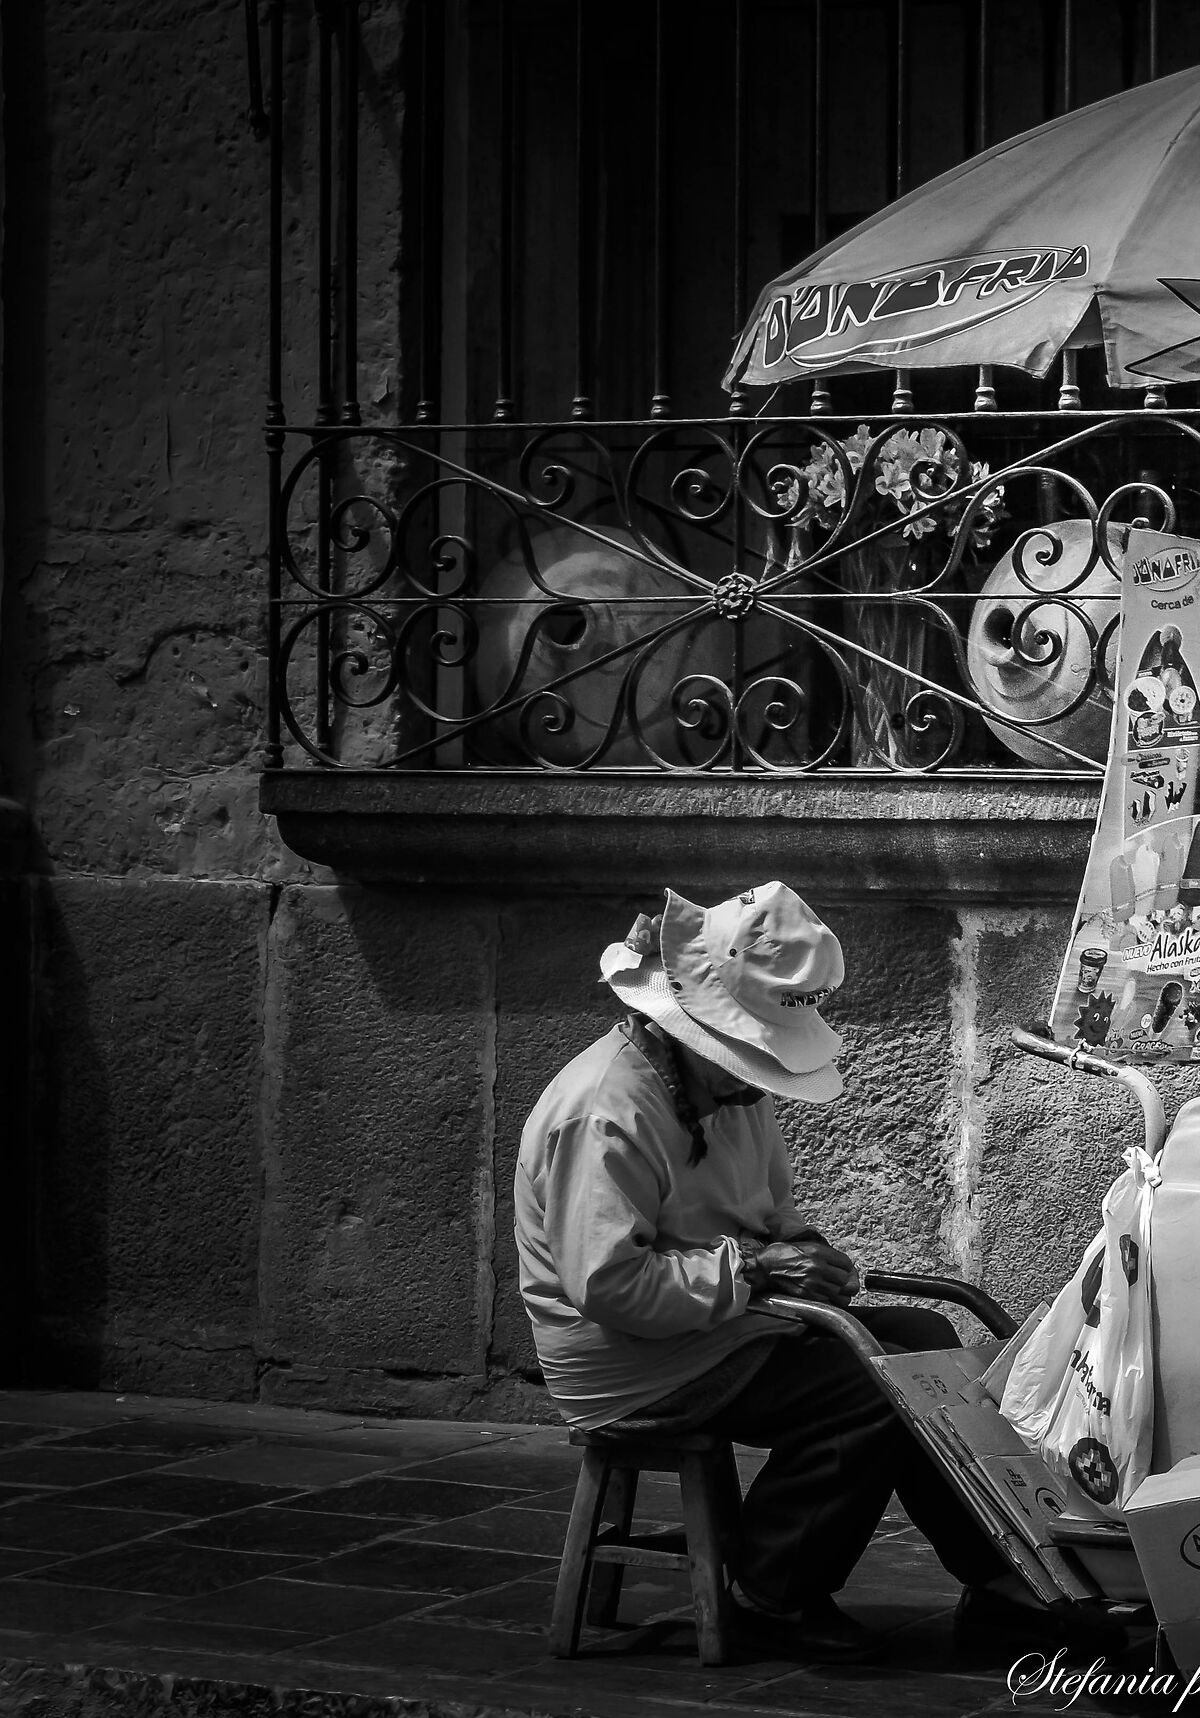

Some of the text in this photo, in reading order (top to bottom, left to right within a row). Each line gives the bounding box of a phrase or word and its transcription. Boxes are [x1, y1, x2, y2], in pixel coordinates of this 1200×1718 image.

[1150, 594, 1195, 611] Cerca de
[1146, 960, 1170, 973] Hecho
[1170, 959, 1184, 970] con
